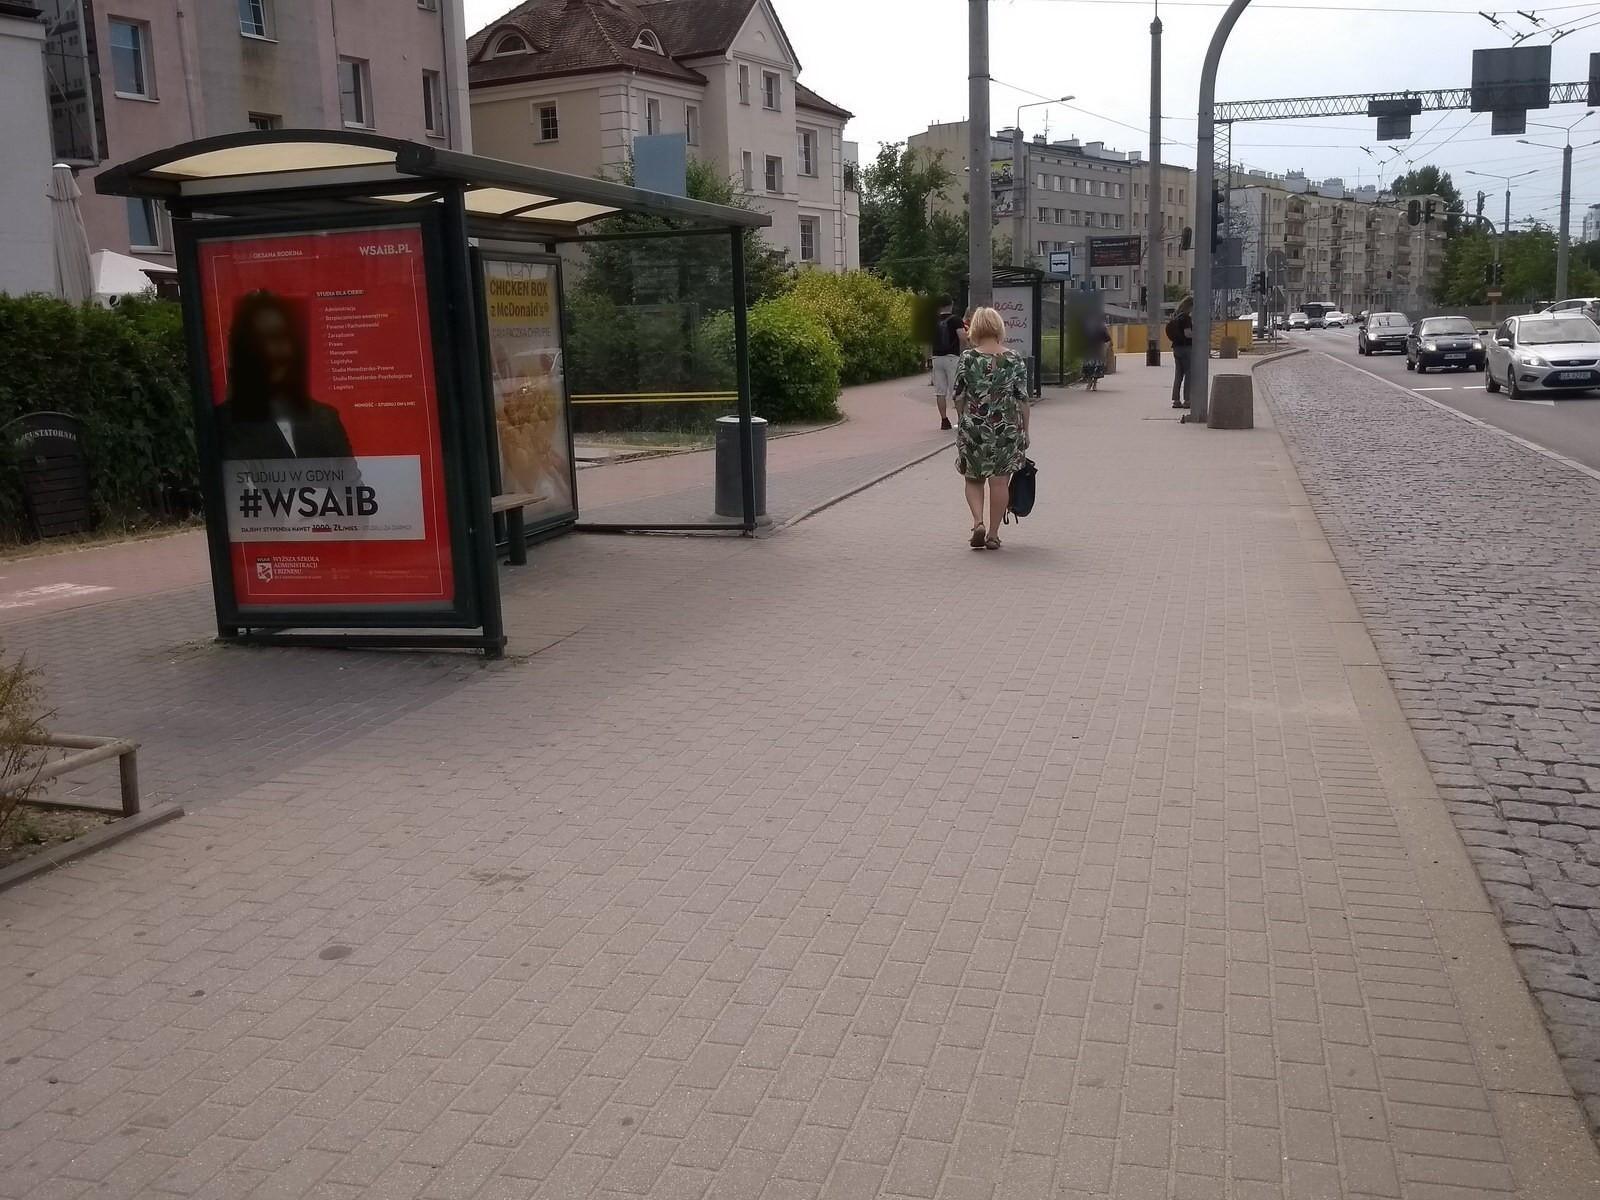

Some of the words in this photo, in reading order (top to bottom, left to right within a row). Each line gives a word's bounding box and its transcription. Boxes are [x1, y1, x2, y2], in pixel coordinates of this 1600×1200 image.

[359, 244, 412, 256] WSAiB.PL
[489, 280, 529, 296] CHICKEN
[531, 281, 548, 296] BOX
[237, 471, 287, 483] STUDIUJ
[290, 471, 302, 481] W
[306, 470, 344, 481] GDYNI
[239, 486, 379, 518] #WSAiB
